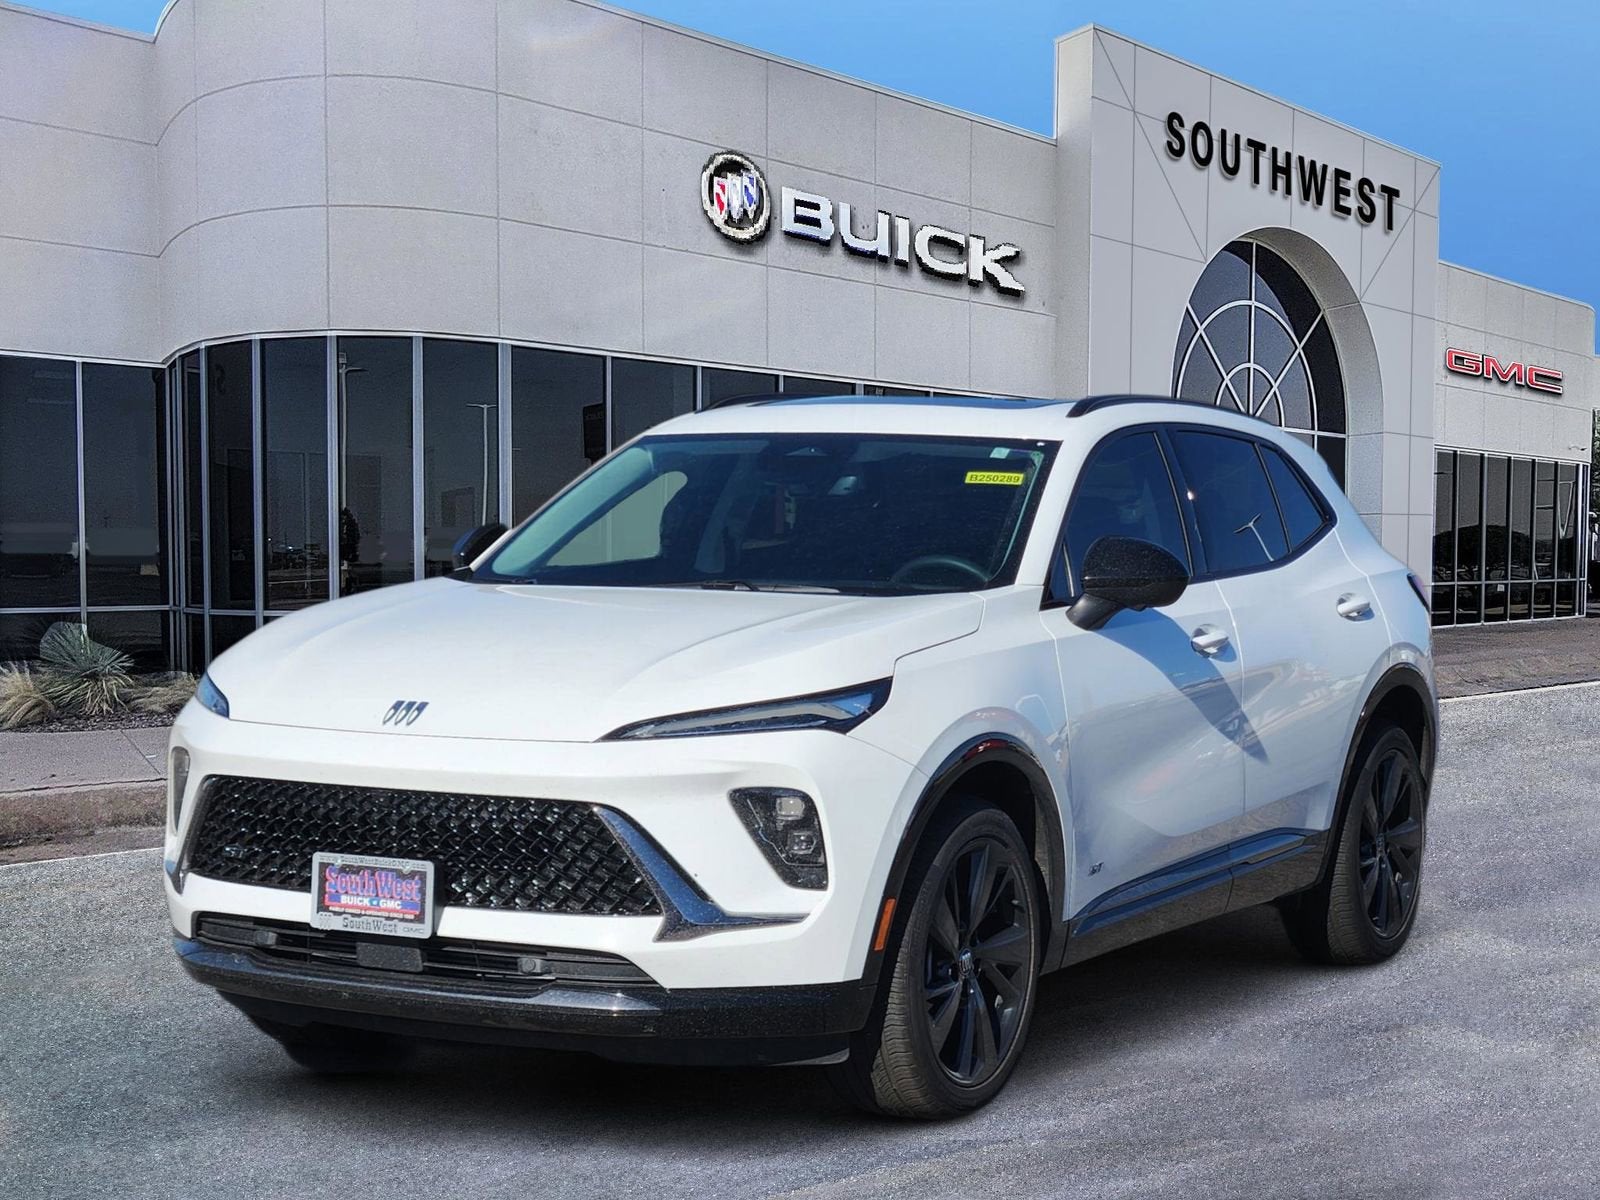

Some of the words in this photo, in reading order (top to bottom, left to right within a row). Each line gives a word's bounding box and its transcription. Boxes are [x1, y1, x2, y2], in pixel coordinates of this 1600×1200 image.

[1166, 111, 1400, 232] SOUTHWEST
[781, 186, 1026, 296] BUICK
[1446, 347, 1563, 395] GMC
[969, 474, 1021, 483] B250289
[325, 865, 421, 901] SouthWest
[341, 895, 369, 906] BUICK
[379, 899, 402, 909] GMC
[342, 917, 398, 933] SouthWest
